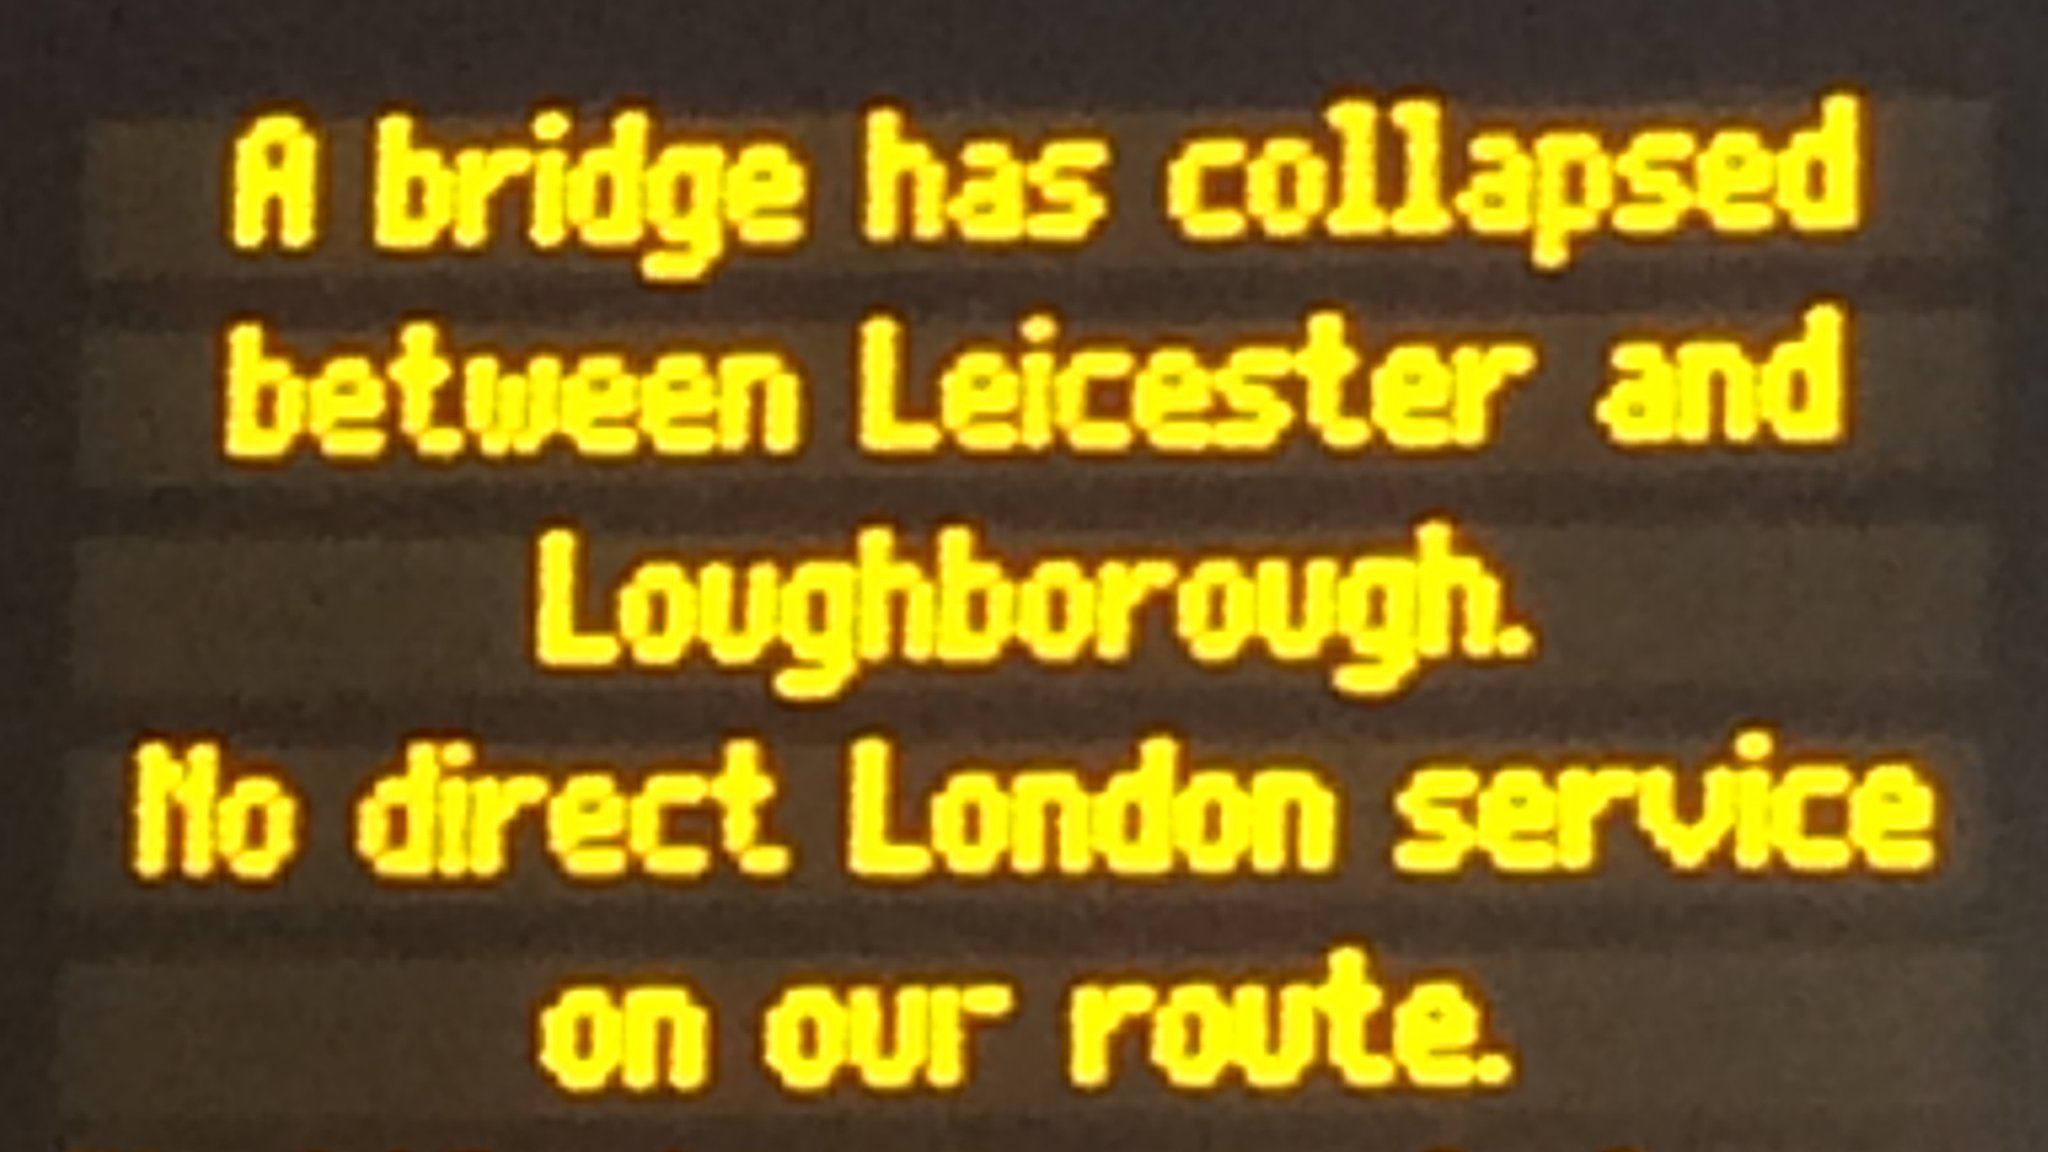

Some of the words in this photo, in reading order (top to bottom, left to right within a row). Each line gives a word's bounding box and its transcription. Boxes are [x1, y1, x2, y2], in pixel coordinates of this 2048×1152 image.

[230, 112, 321, 251] A
[371, 108, 809, 283] bridge
[861, 106, 1112, 246] has
[1165, 91, 1864, 271] collapsed
[222, 319, 804, 460] between
[856, 309, 1539, 454] Leicester
[1593, 301, 1847, 447] and
[534, 518, 1536, 703] Loughborough.
[131, 739, 300, 881] No
[354, 737, 793, 880] direct
[845, 733, 1341, 880] London
[1390, 728, 1939, 875] service
[537, 979, 711, 1094] on
[761, 978, 1016, 1093] our
[1067, 943, 1515, 1091] route.
